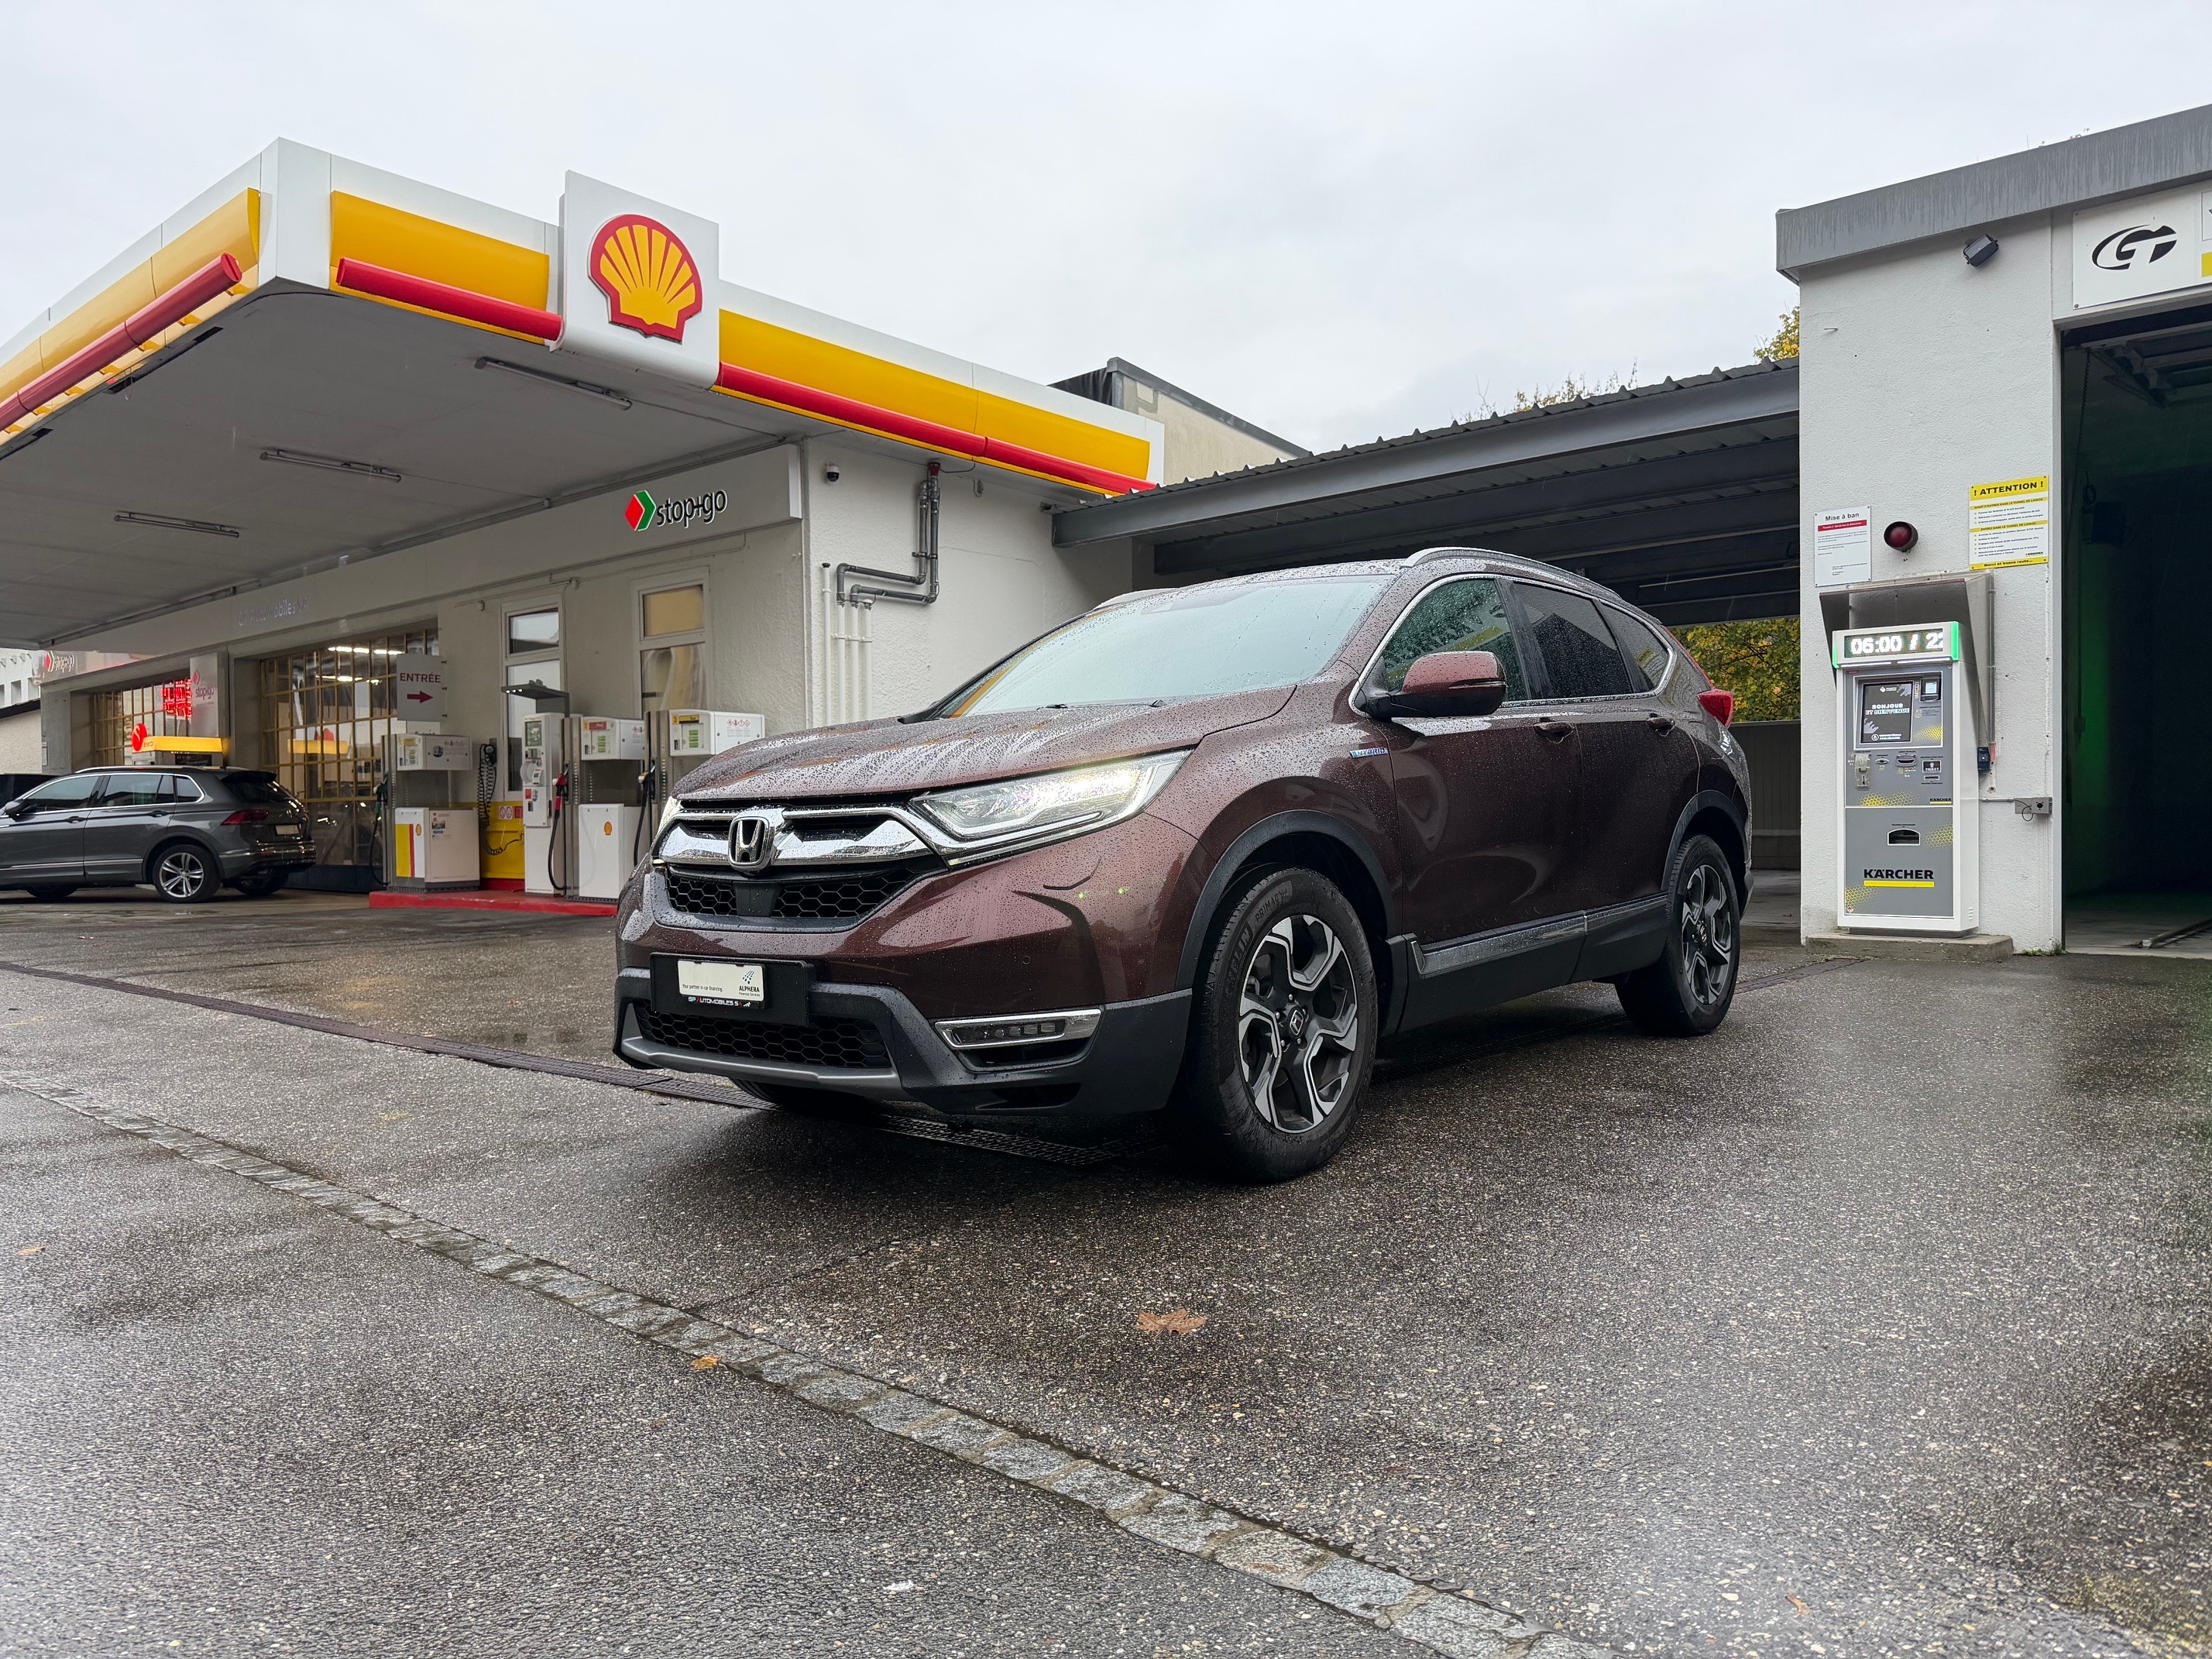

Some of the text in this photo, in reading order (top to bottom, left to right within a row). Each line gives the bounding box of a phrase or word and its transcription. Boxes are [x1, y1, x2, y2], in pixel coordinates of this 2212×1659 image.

[1980, 482, 2037, 496] ATTENTION
[1850, 635, 1903, 654] 06:00
[400, 672, 441, 683] ENTRÉE
[1358, 747, 1385, 756] HYBRID
[1863, 869, 1934, 880] KÄRCHER
